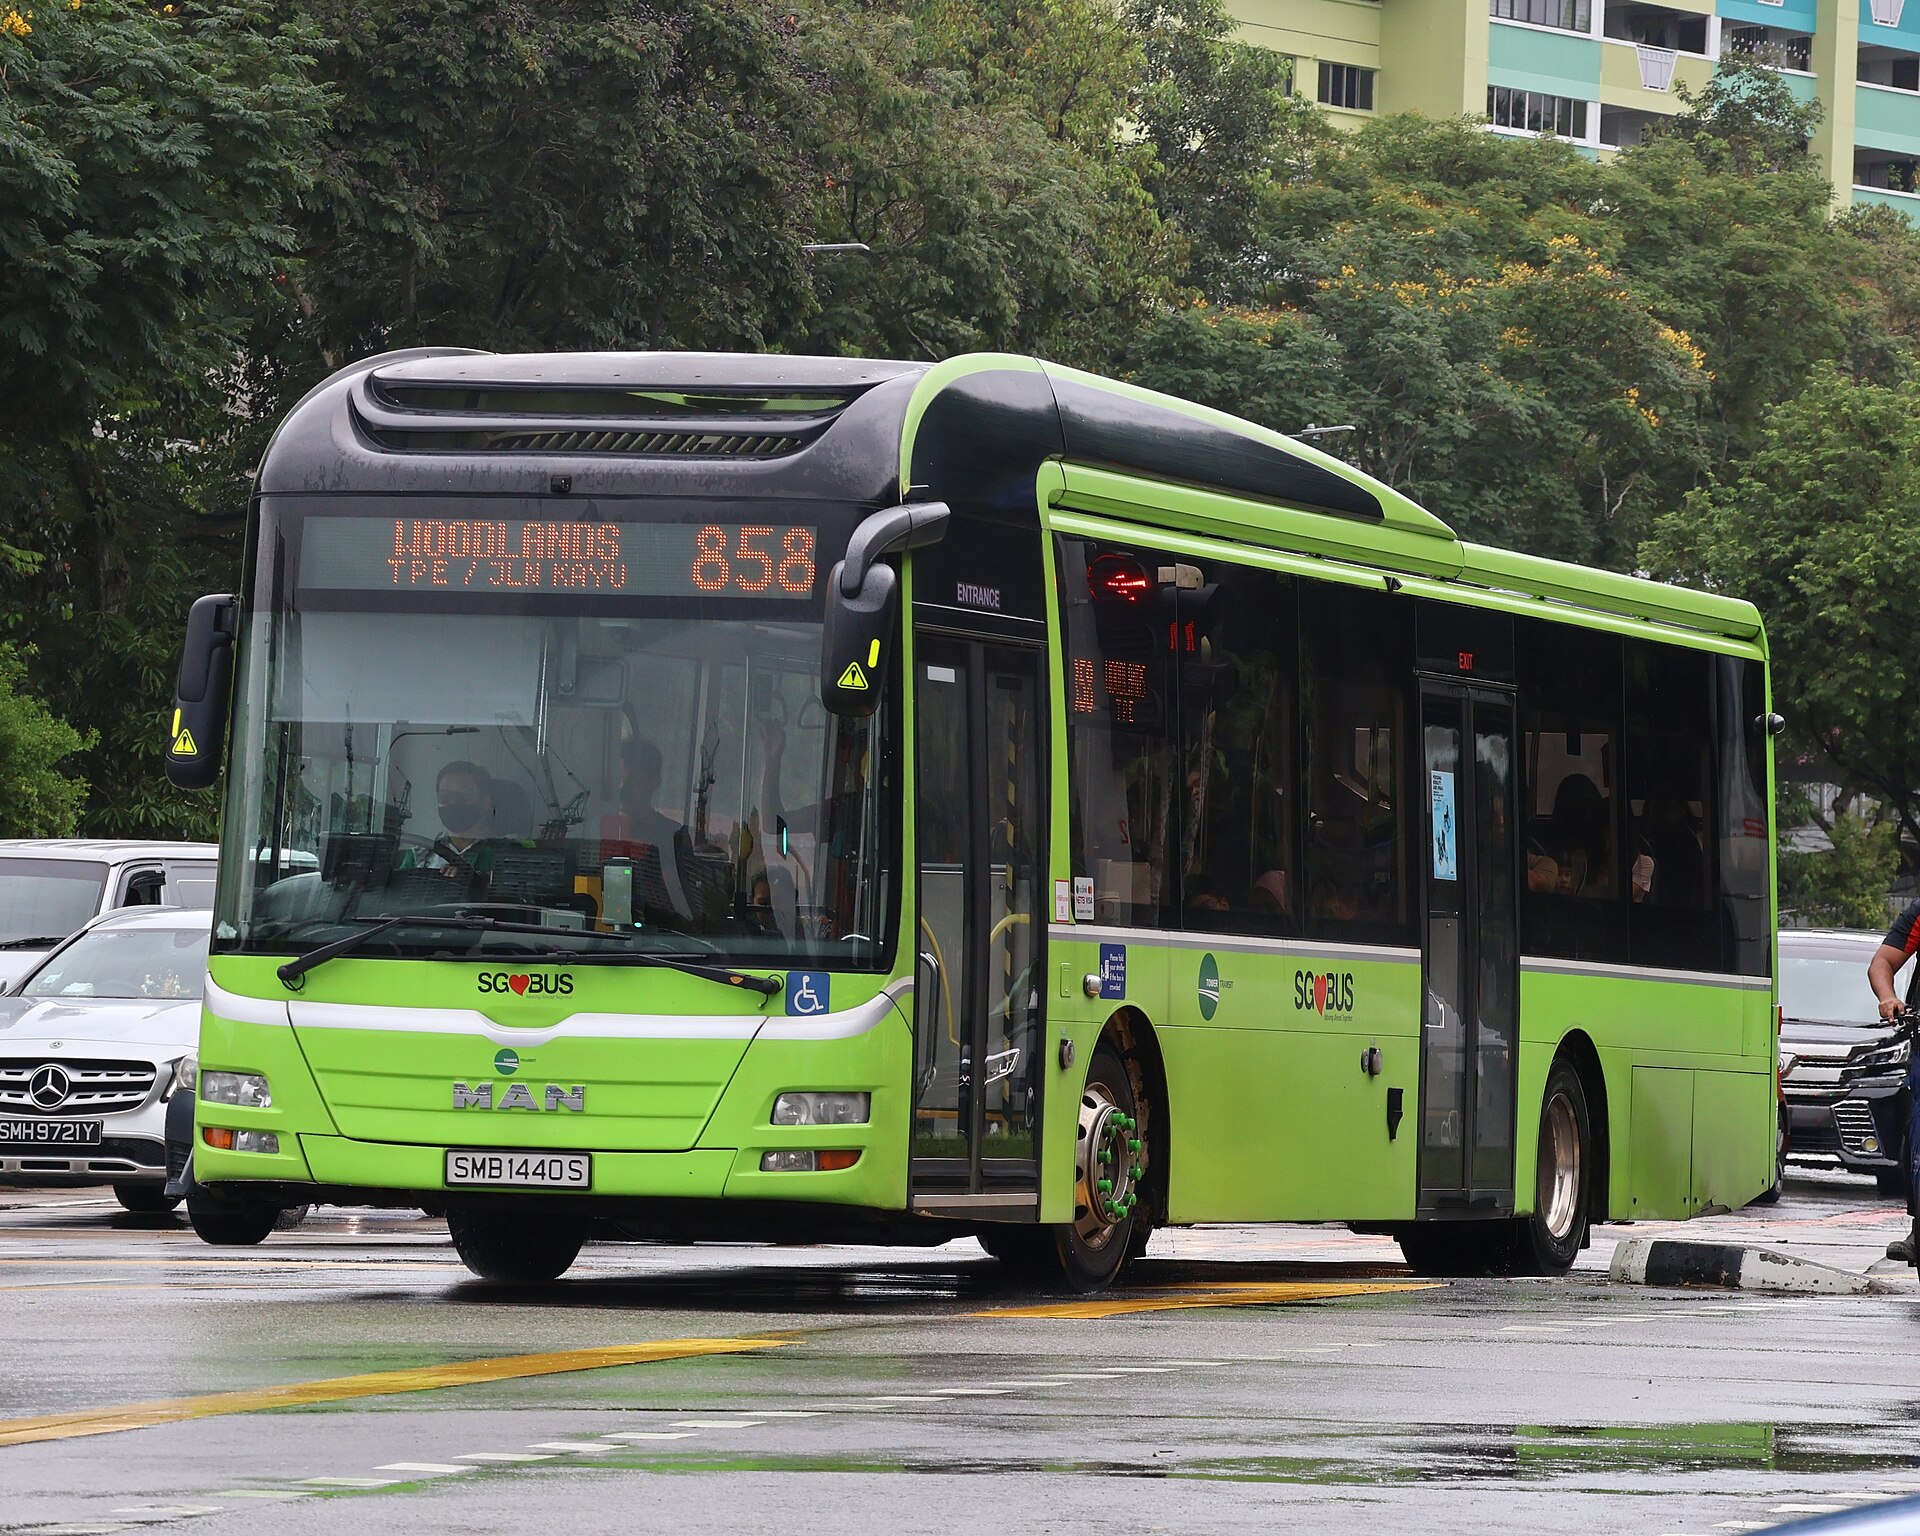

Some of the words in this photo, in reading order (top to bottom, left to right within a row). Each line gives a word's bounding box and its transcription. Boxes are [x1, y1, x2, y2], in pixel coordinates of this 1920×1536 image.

[393, 520, 621, 561] WOODLANDS
[690, 525, 817, 593] 858
[387, 557, 449, 586] TPE
[489, 560, 540, 588] JLN
[551, 562, 628, 588] KAYU
[957, 583, 1000, 608] ENTRANCE
[1458, 652, 1474, 670] EXIT
[1205, 978, 1219, 988] TOWER
[452, 1080, 586, 1112] MAN
[0, 1122, 95, 1141] SMH9721Y
[453, 1156, 584, 1182] SMB1440S
